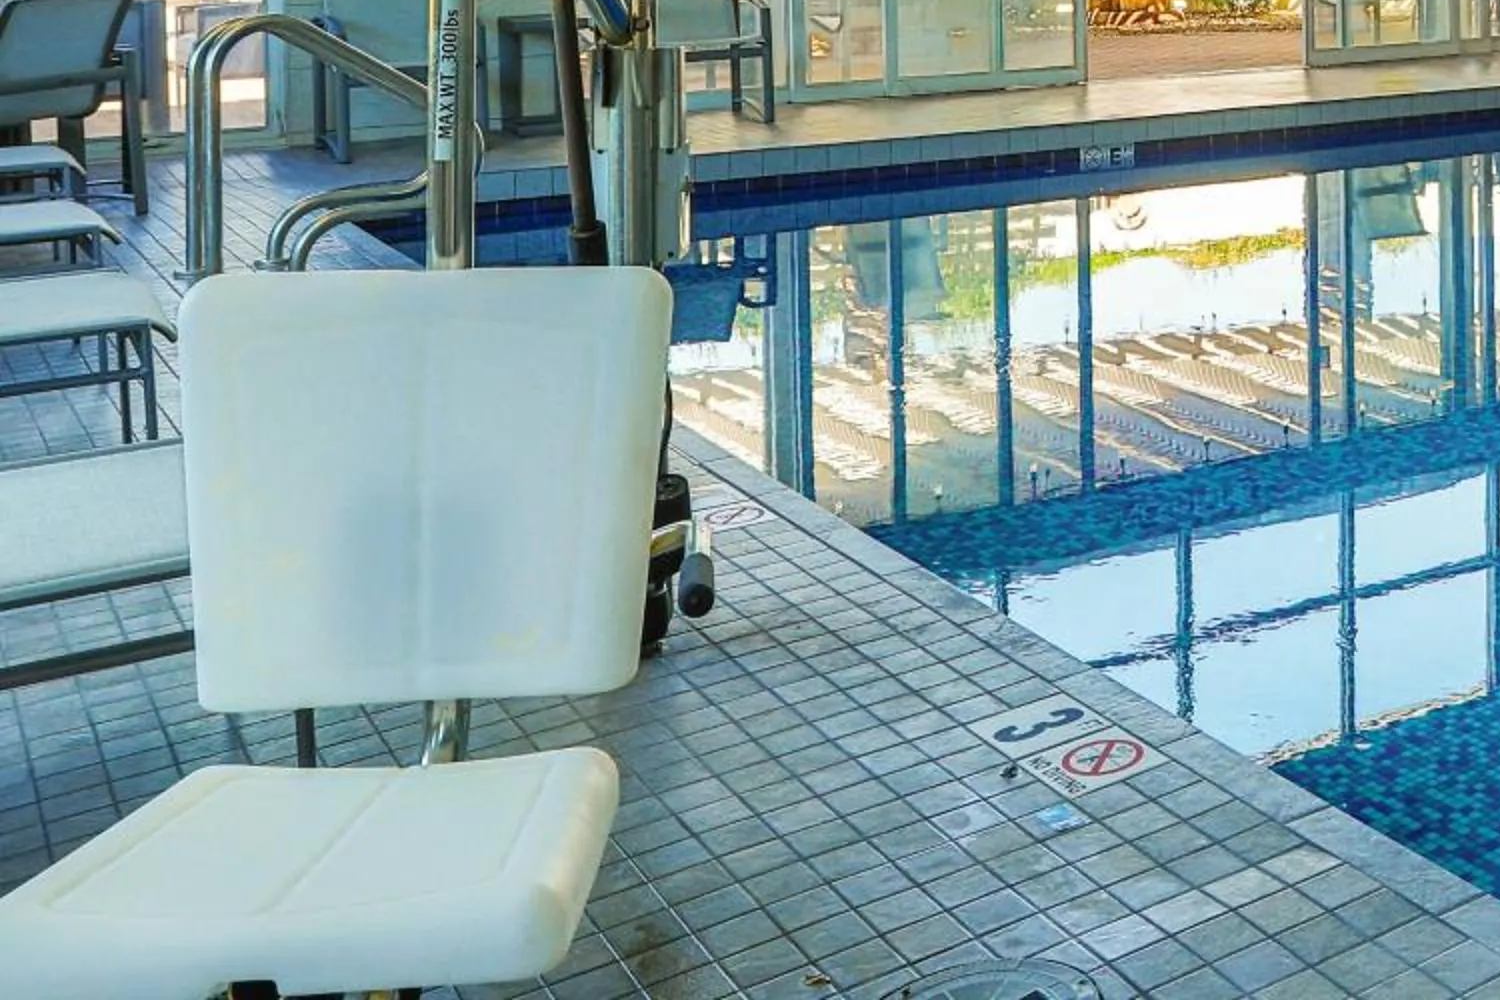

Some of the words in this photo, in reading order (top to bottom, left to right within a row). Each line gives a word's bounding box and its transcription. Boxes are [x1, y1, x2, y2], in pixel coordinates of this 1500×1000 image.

[441, 8, 459, 61] 300lbs
[440, 72, 455, 97] WT
[438, 103, 455, 139] MAX
[993, 707, 1085, 743] 3
